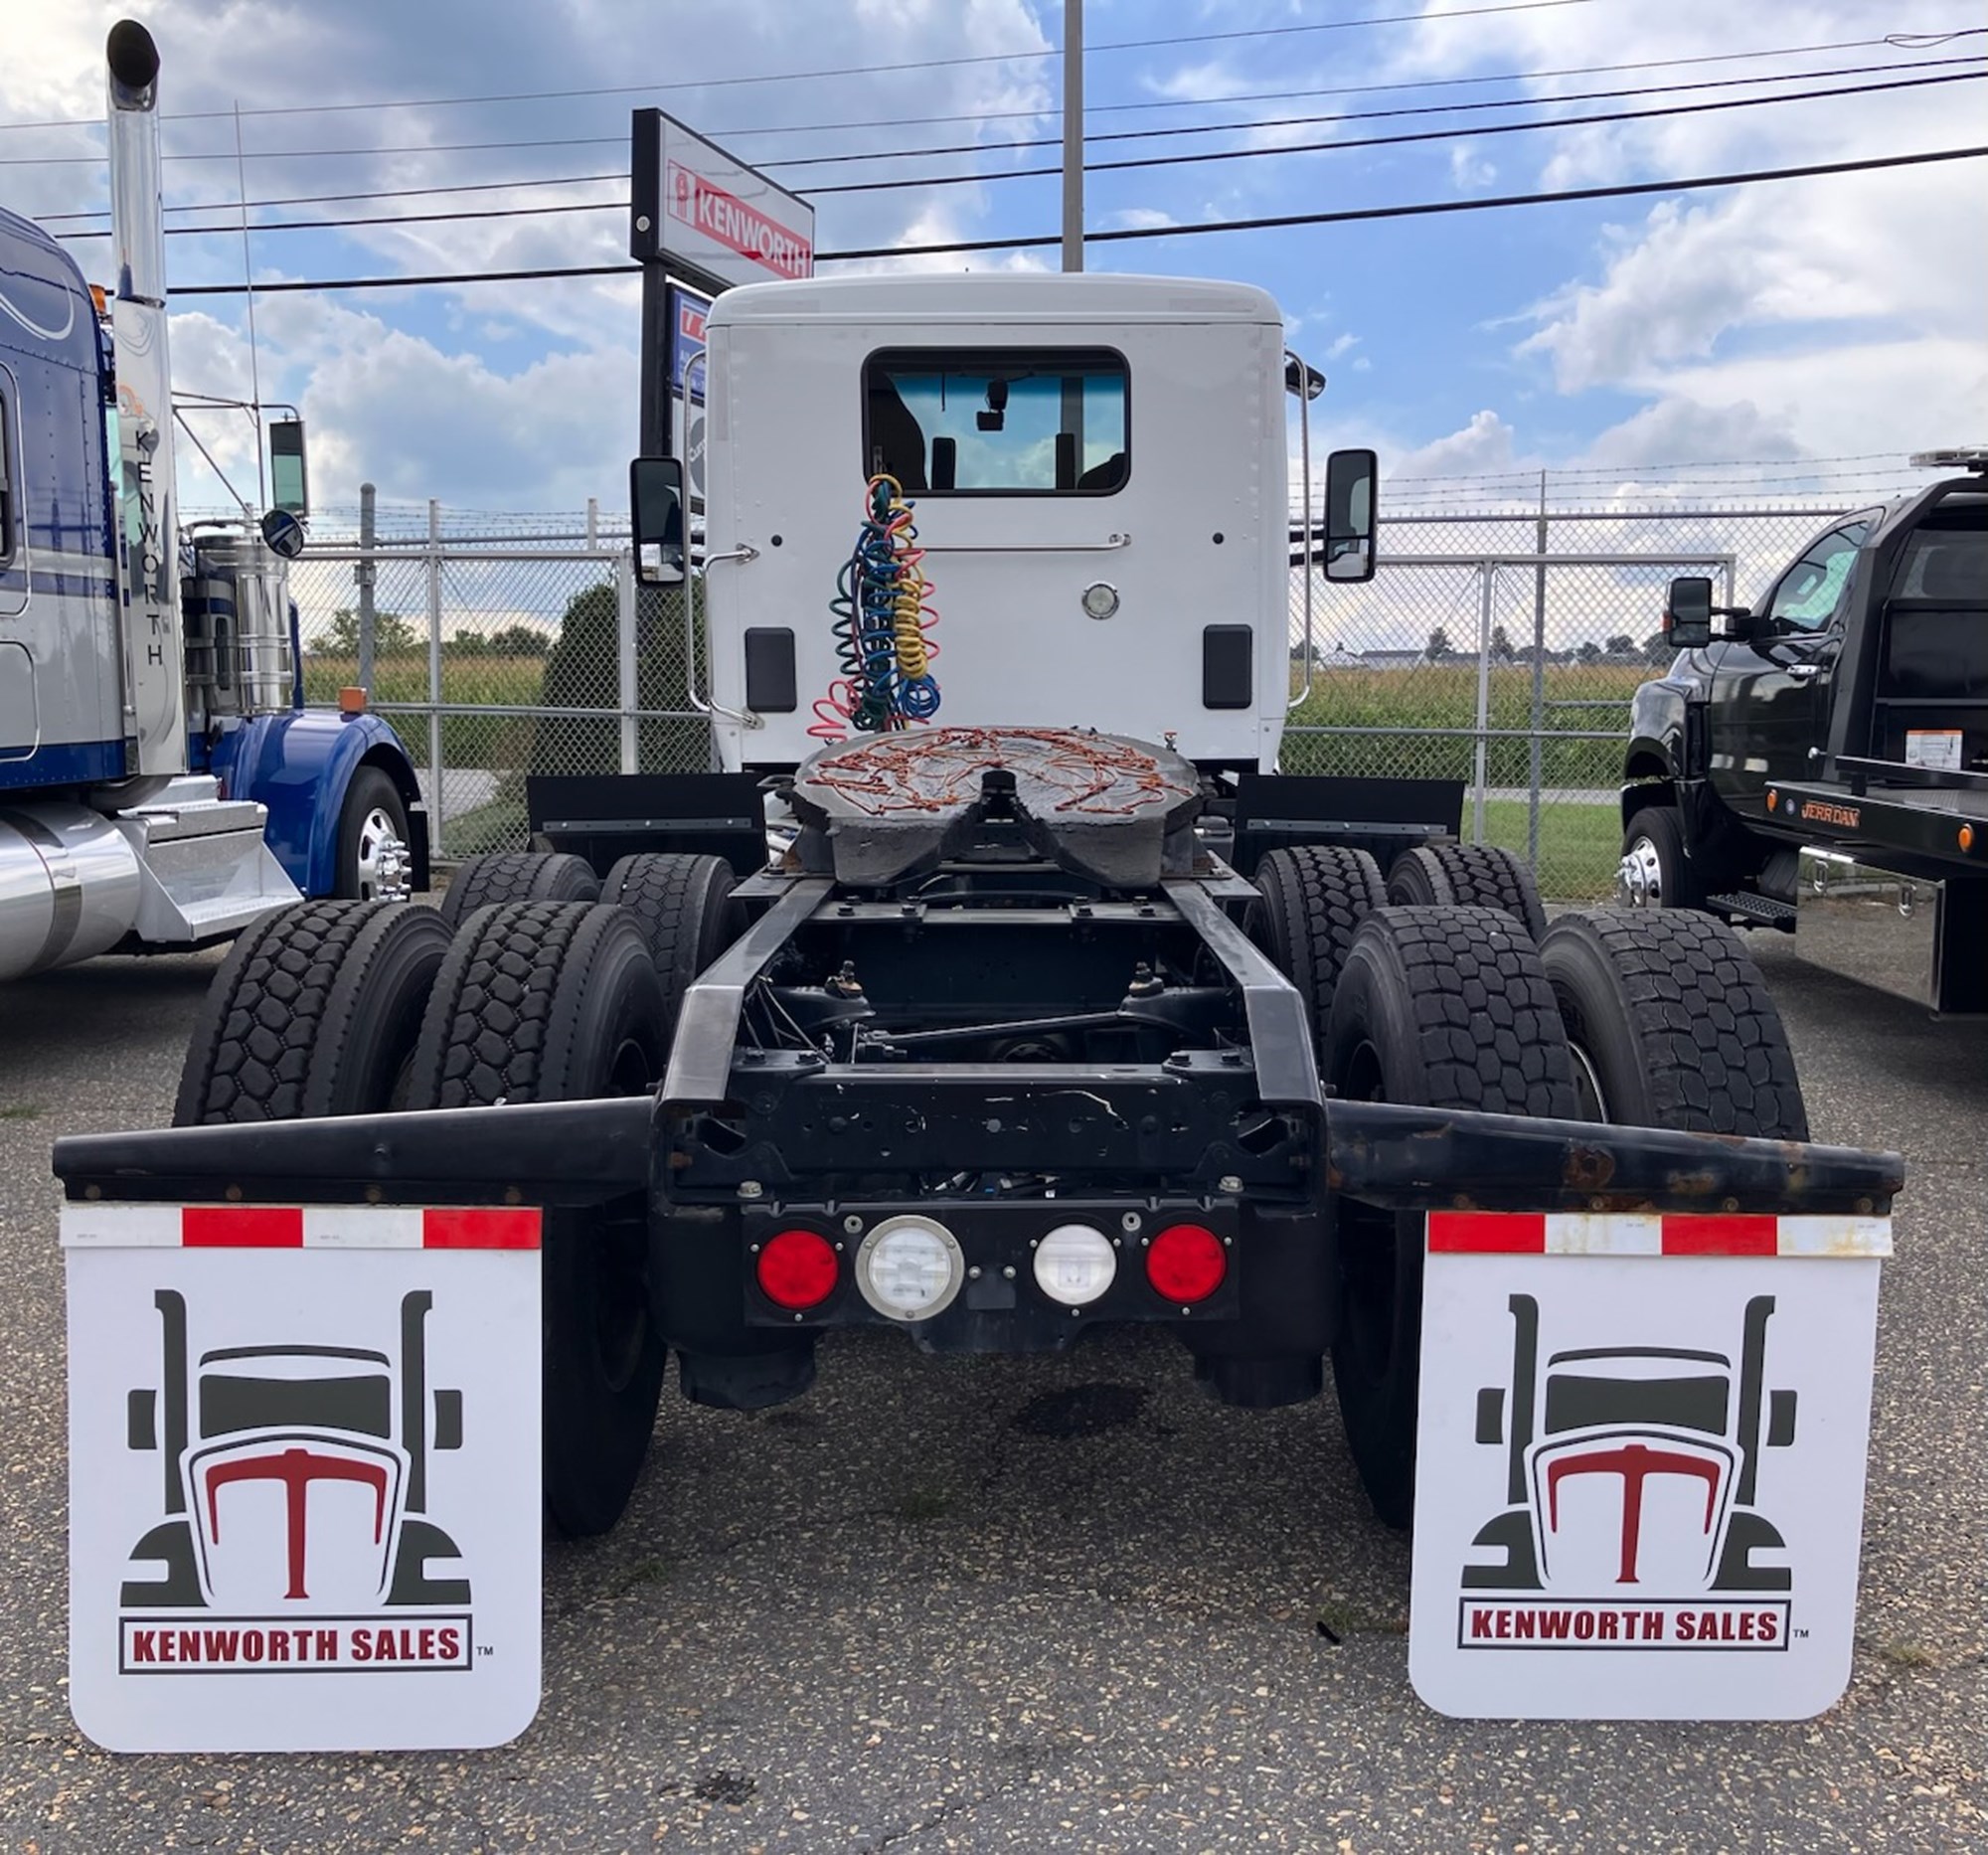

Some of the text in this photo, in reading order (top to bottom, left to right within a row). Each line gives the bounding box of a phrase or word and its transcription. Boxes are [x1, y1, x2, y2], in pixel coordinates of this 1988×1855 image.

[699, 187, 808, 279] KENWORTH
[134, 429, 163, 667] KENWORTH
[132, 1627, 460, 1662] KENWORTH SALES
[1471, 1609, 1778, 1641] KENWORTH SALES
